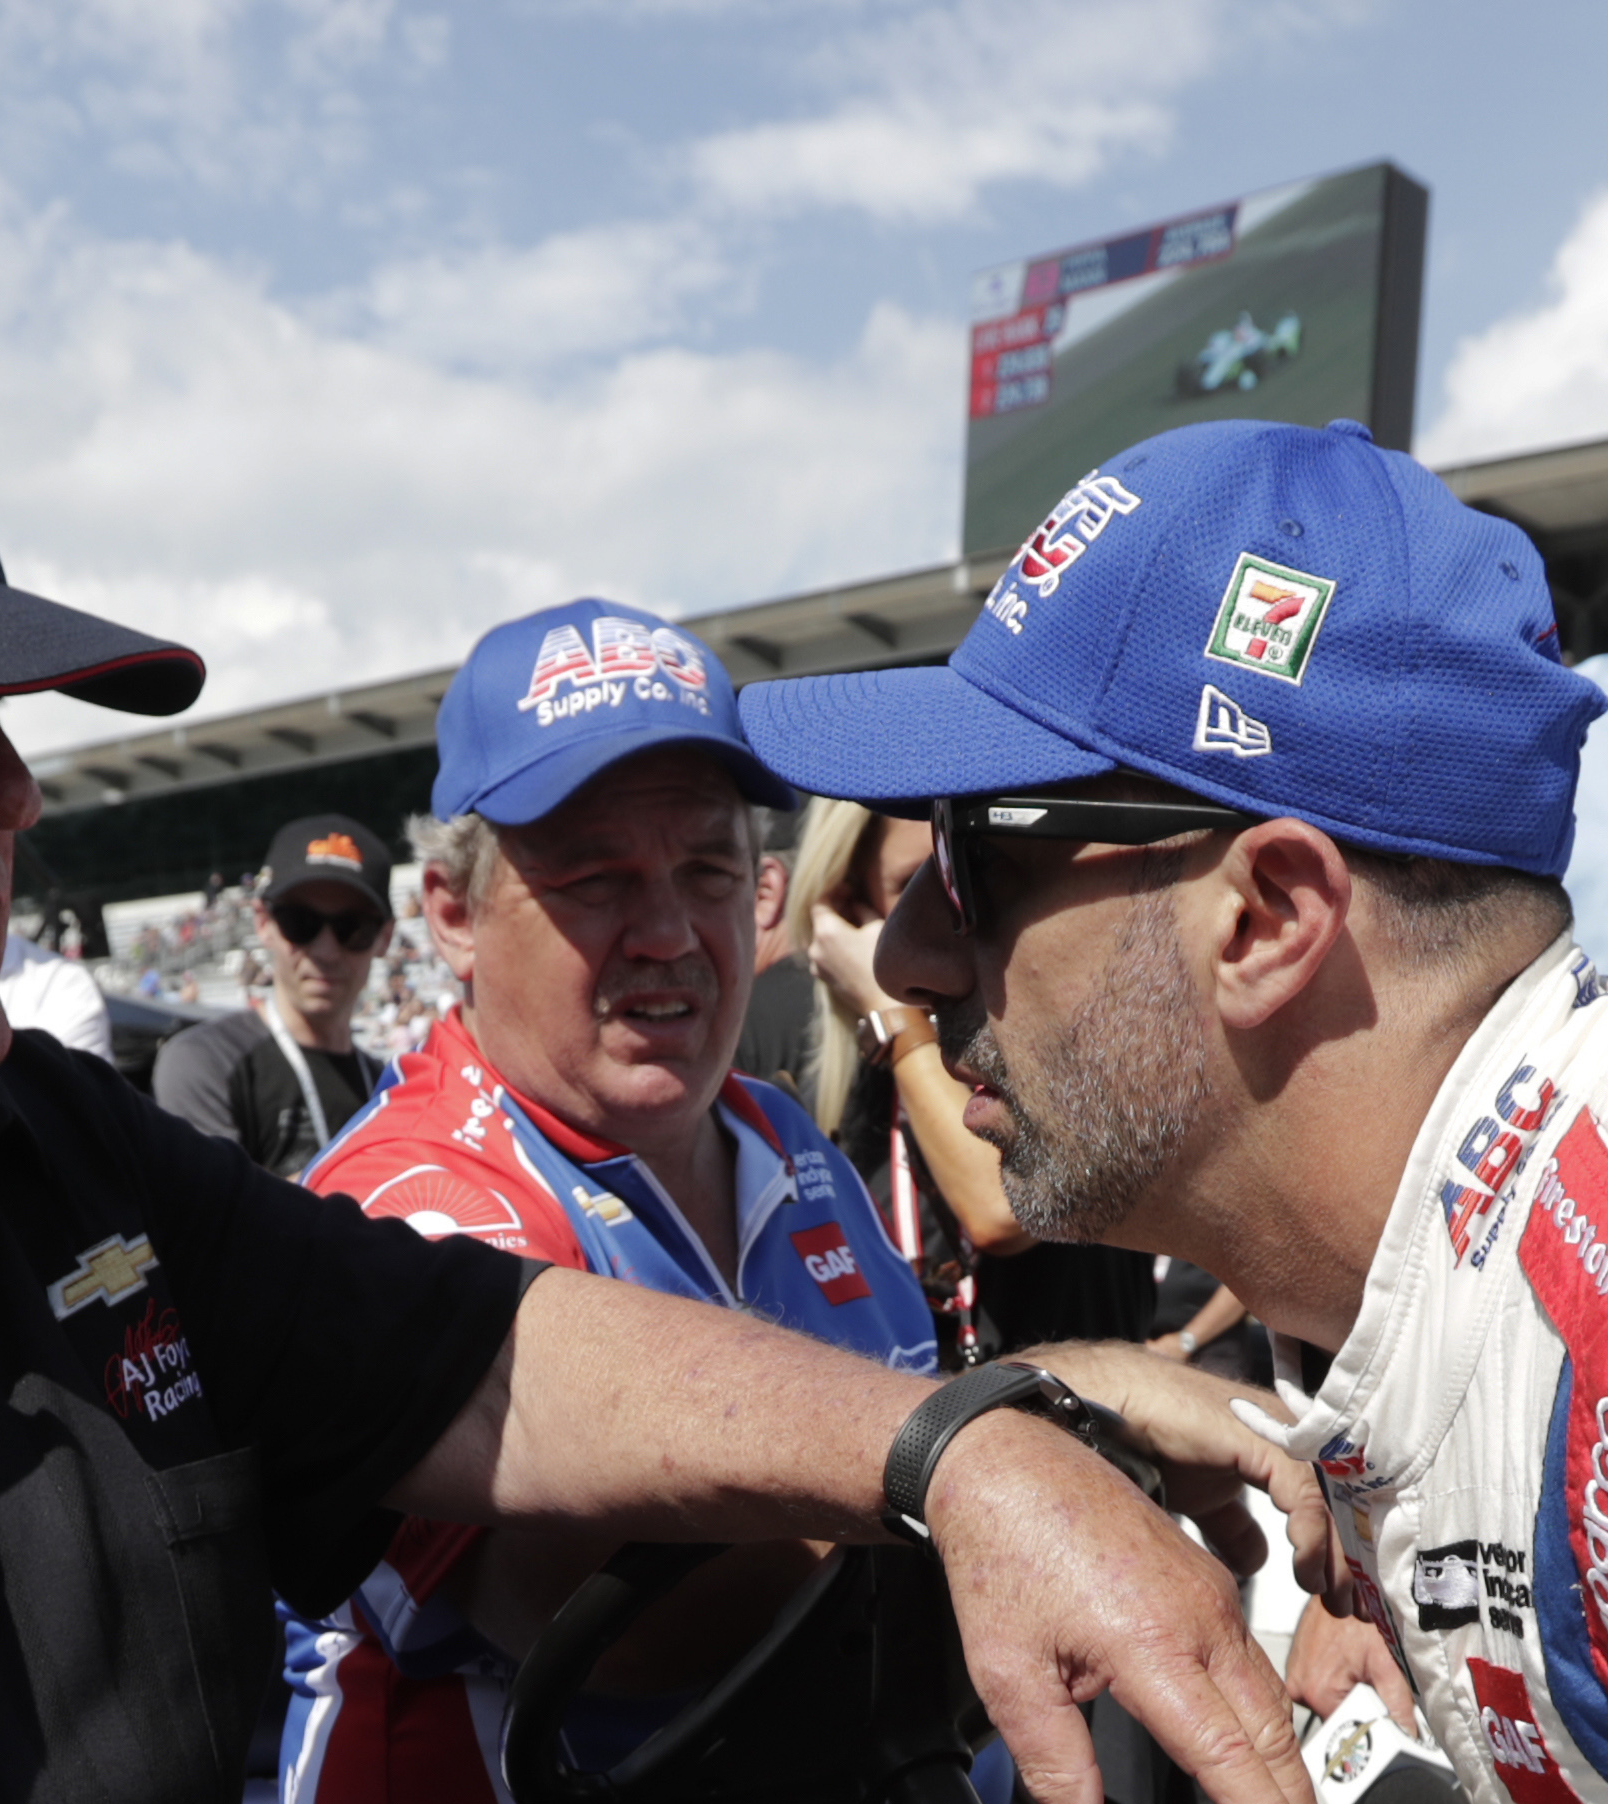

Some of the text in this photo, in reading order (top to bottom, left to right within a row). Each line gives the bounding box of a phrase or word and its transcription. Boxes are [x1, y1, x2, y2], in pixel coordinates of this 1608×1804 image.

[517, 616, 707, 711] ABC
[536, 680, 627, 727] Supply
[633, 676, 674, 701] Co.
[1441, 1053, 1554, 1269] ABC
[1471, 1185, 1517, 1272] Supply
[804, 1245, 858, 1283] GAF
[122, 1352, 156, 1391] AJ
[1480, 1705, 1547, 1774] GAF
